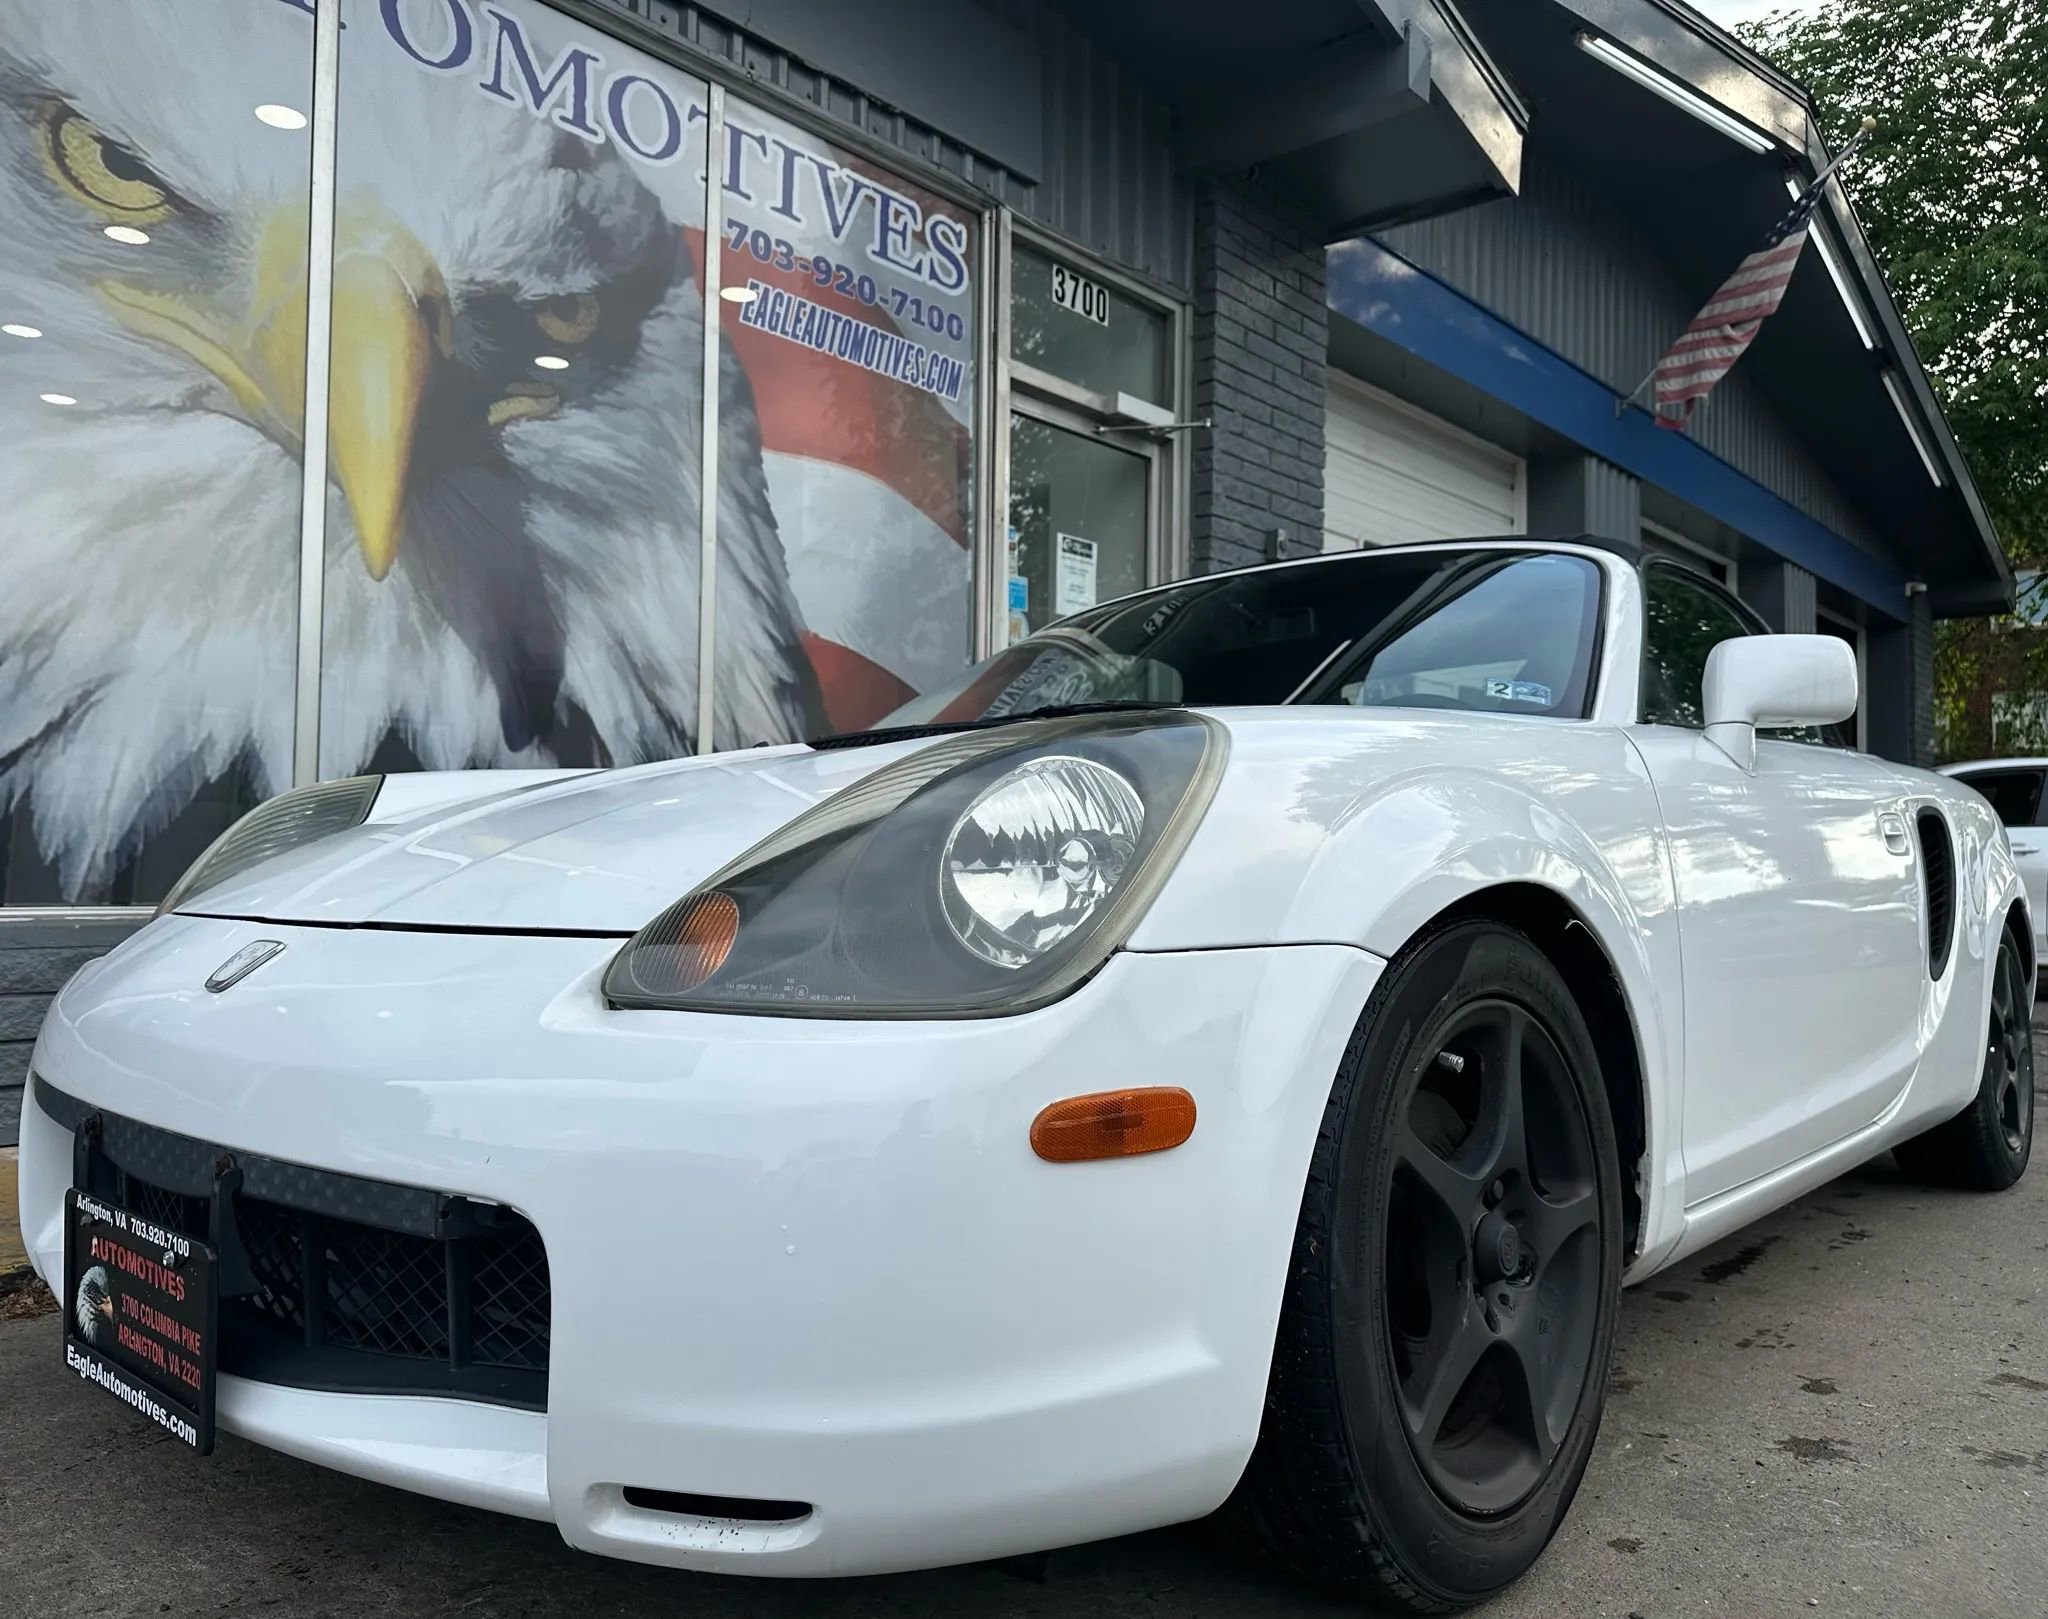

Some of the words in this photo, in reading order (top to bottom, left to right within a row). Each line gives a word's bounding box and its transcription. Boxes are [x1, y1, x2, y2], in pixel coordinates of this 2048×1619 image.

[281, 0, 966, 290] OMOTIVES
[726, 217, 964, 342] 703-920-7100
[1055, 267, 1106, 323] 3700
[740, 280, 965, 400] EAGLEAUTOMOTIVES.COM
[76, 1194, 114, 1228] Arlington,
[114, 1210, 127, 1231] VA
[130, 1217, 190, 1258] 703.920.7100
[90, 1235, 185, 1302] AUTOMOTIVES
[118, 1323, 167, 1375] ARLINGTON,
[168, 1351, 181, 1378] VA
[121, 1293, 139, 1321] 3700
[140, 1302, 181, 1344] COLUMBIA
[182, 1325, 201, 1356] PIKE
[66, 1343, 197, 1448] EagleAutomotives.com
